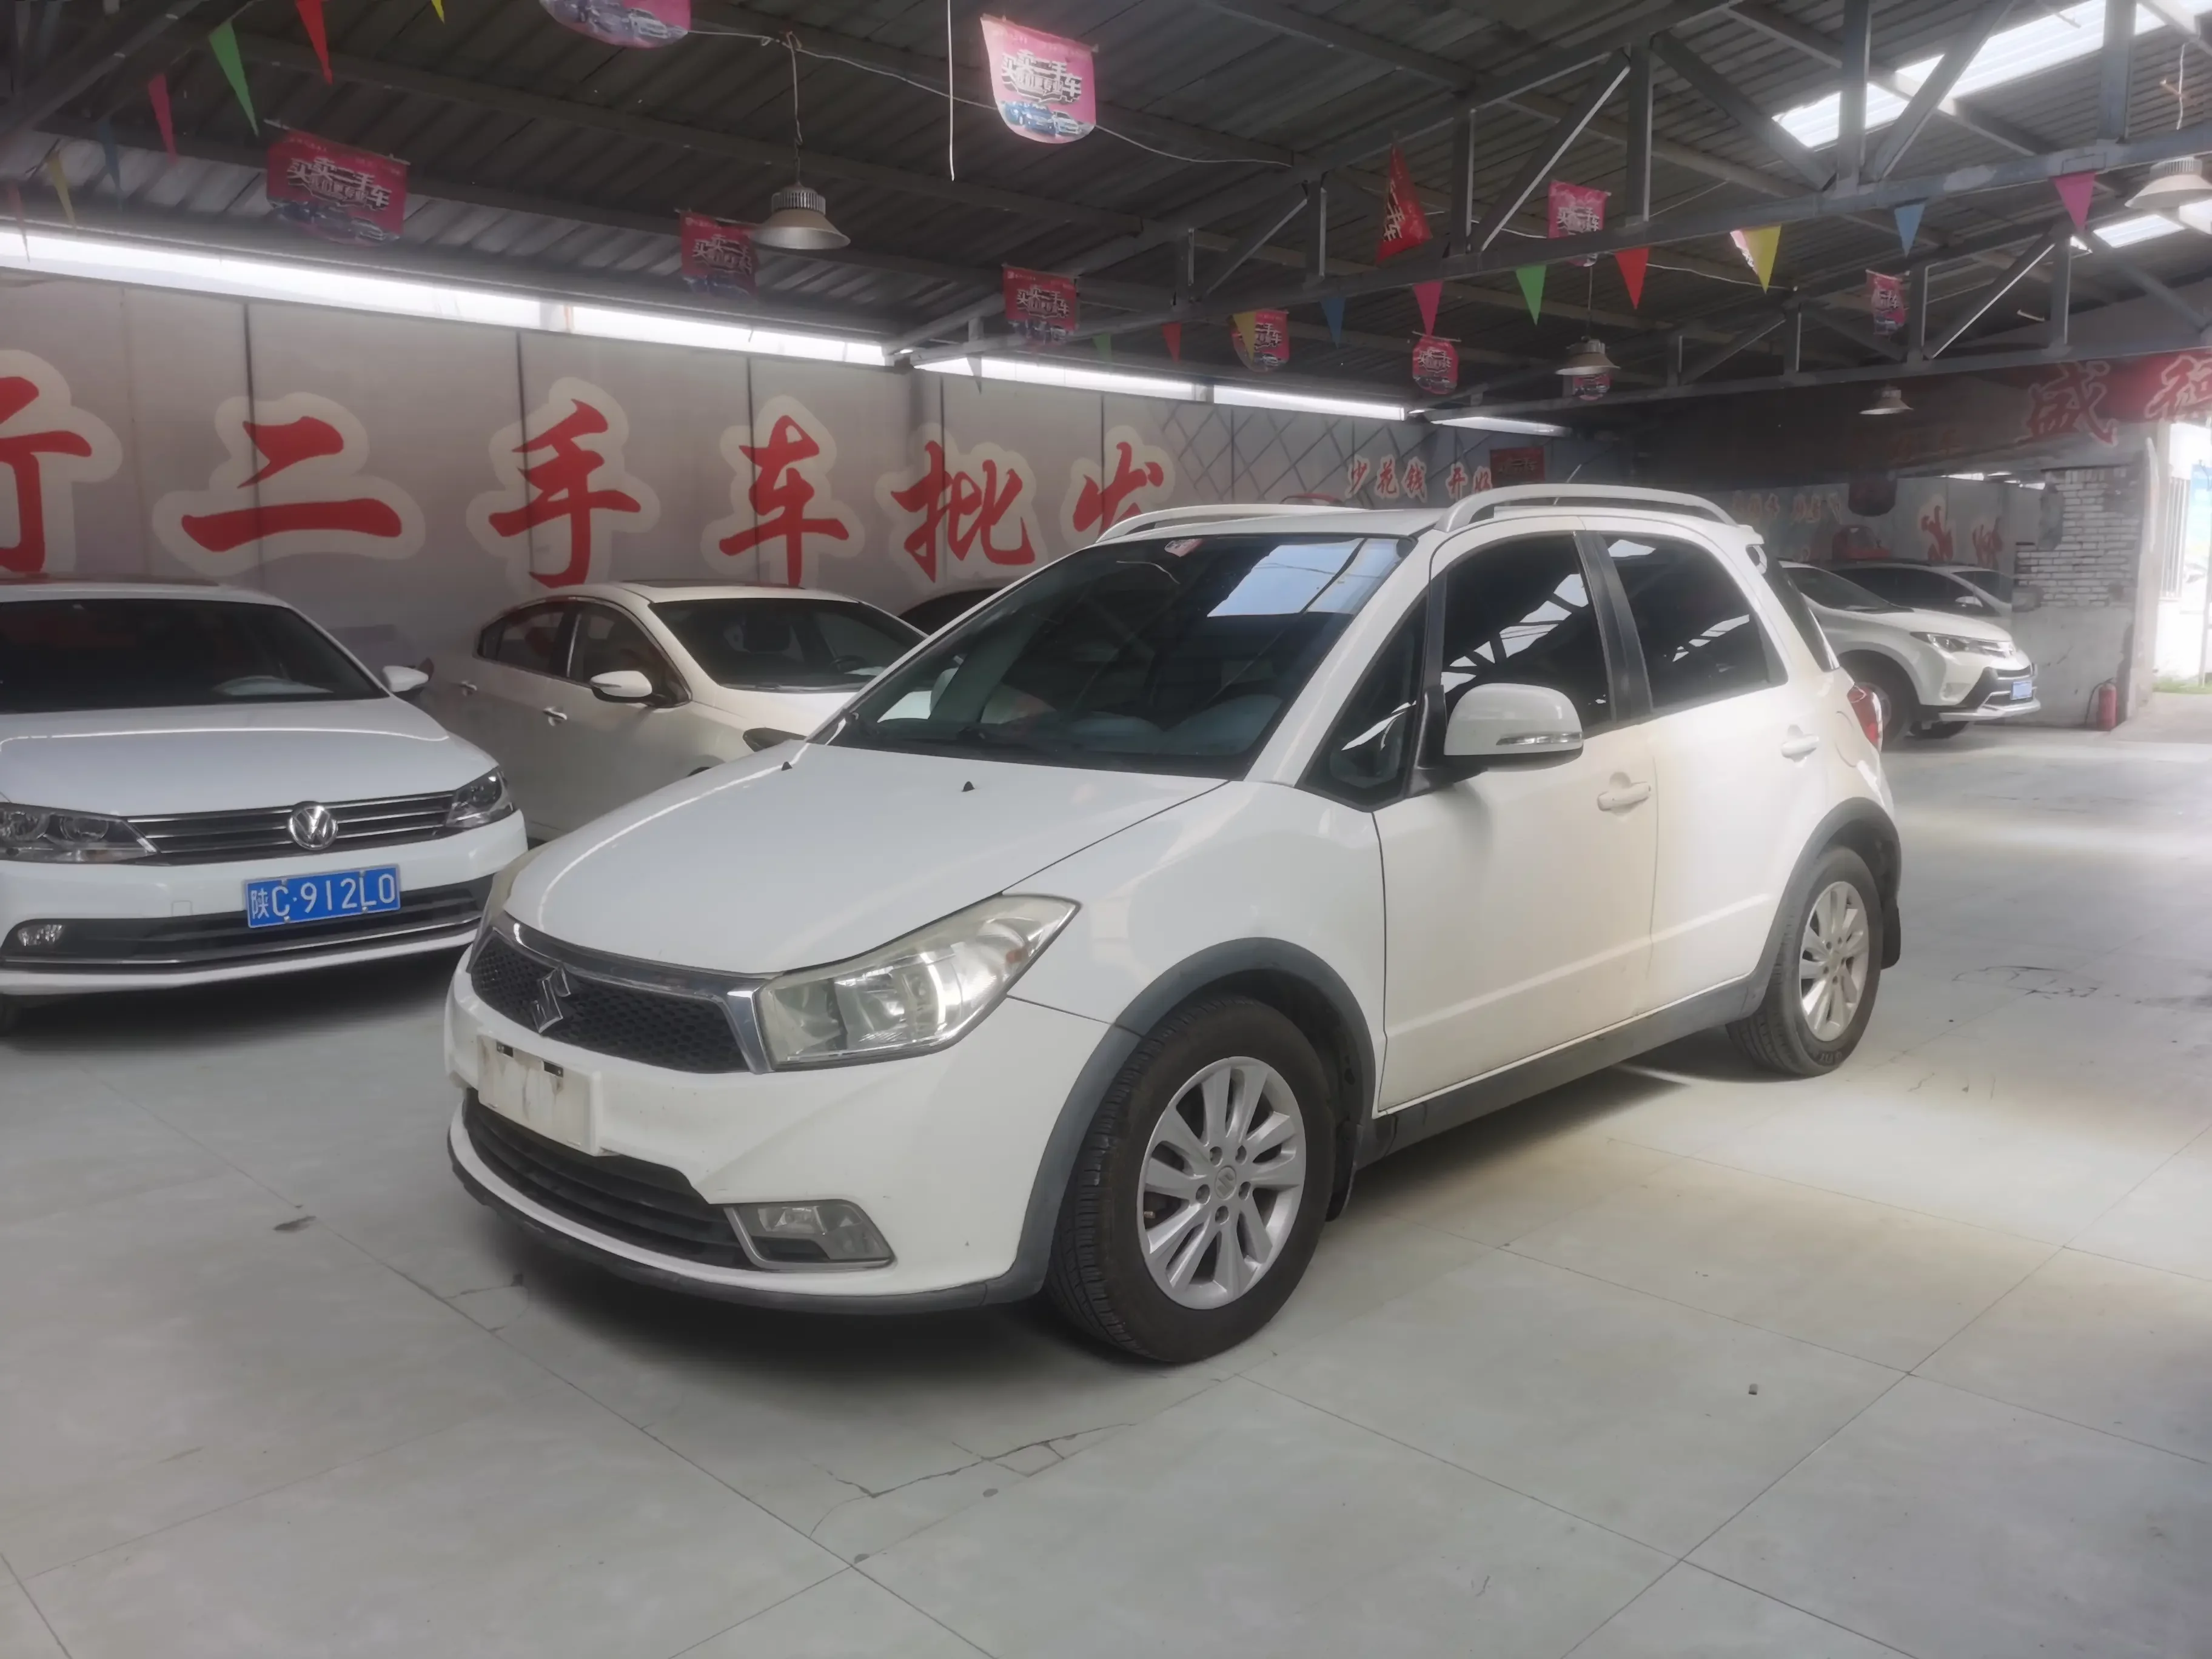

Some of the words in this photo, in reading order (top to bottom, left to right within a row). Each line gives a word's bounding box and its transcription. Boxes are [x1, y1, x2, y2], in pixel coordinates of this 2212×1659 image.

[1001, 49, 1082, 98] 买卖二手车
[286, 156, 392, 207] 买卖二手车
[1254, 322, 1283, 344] 二手车
